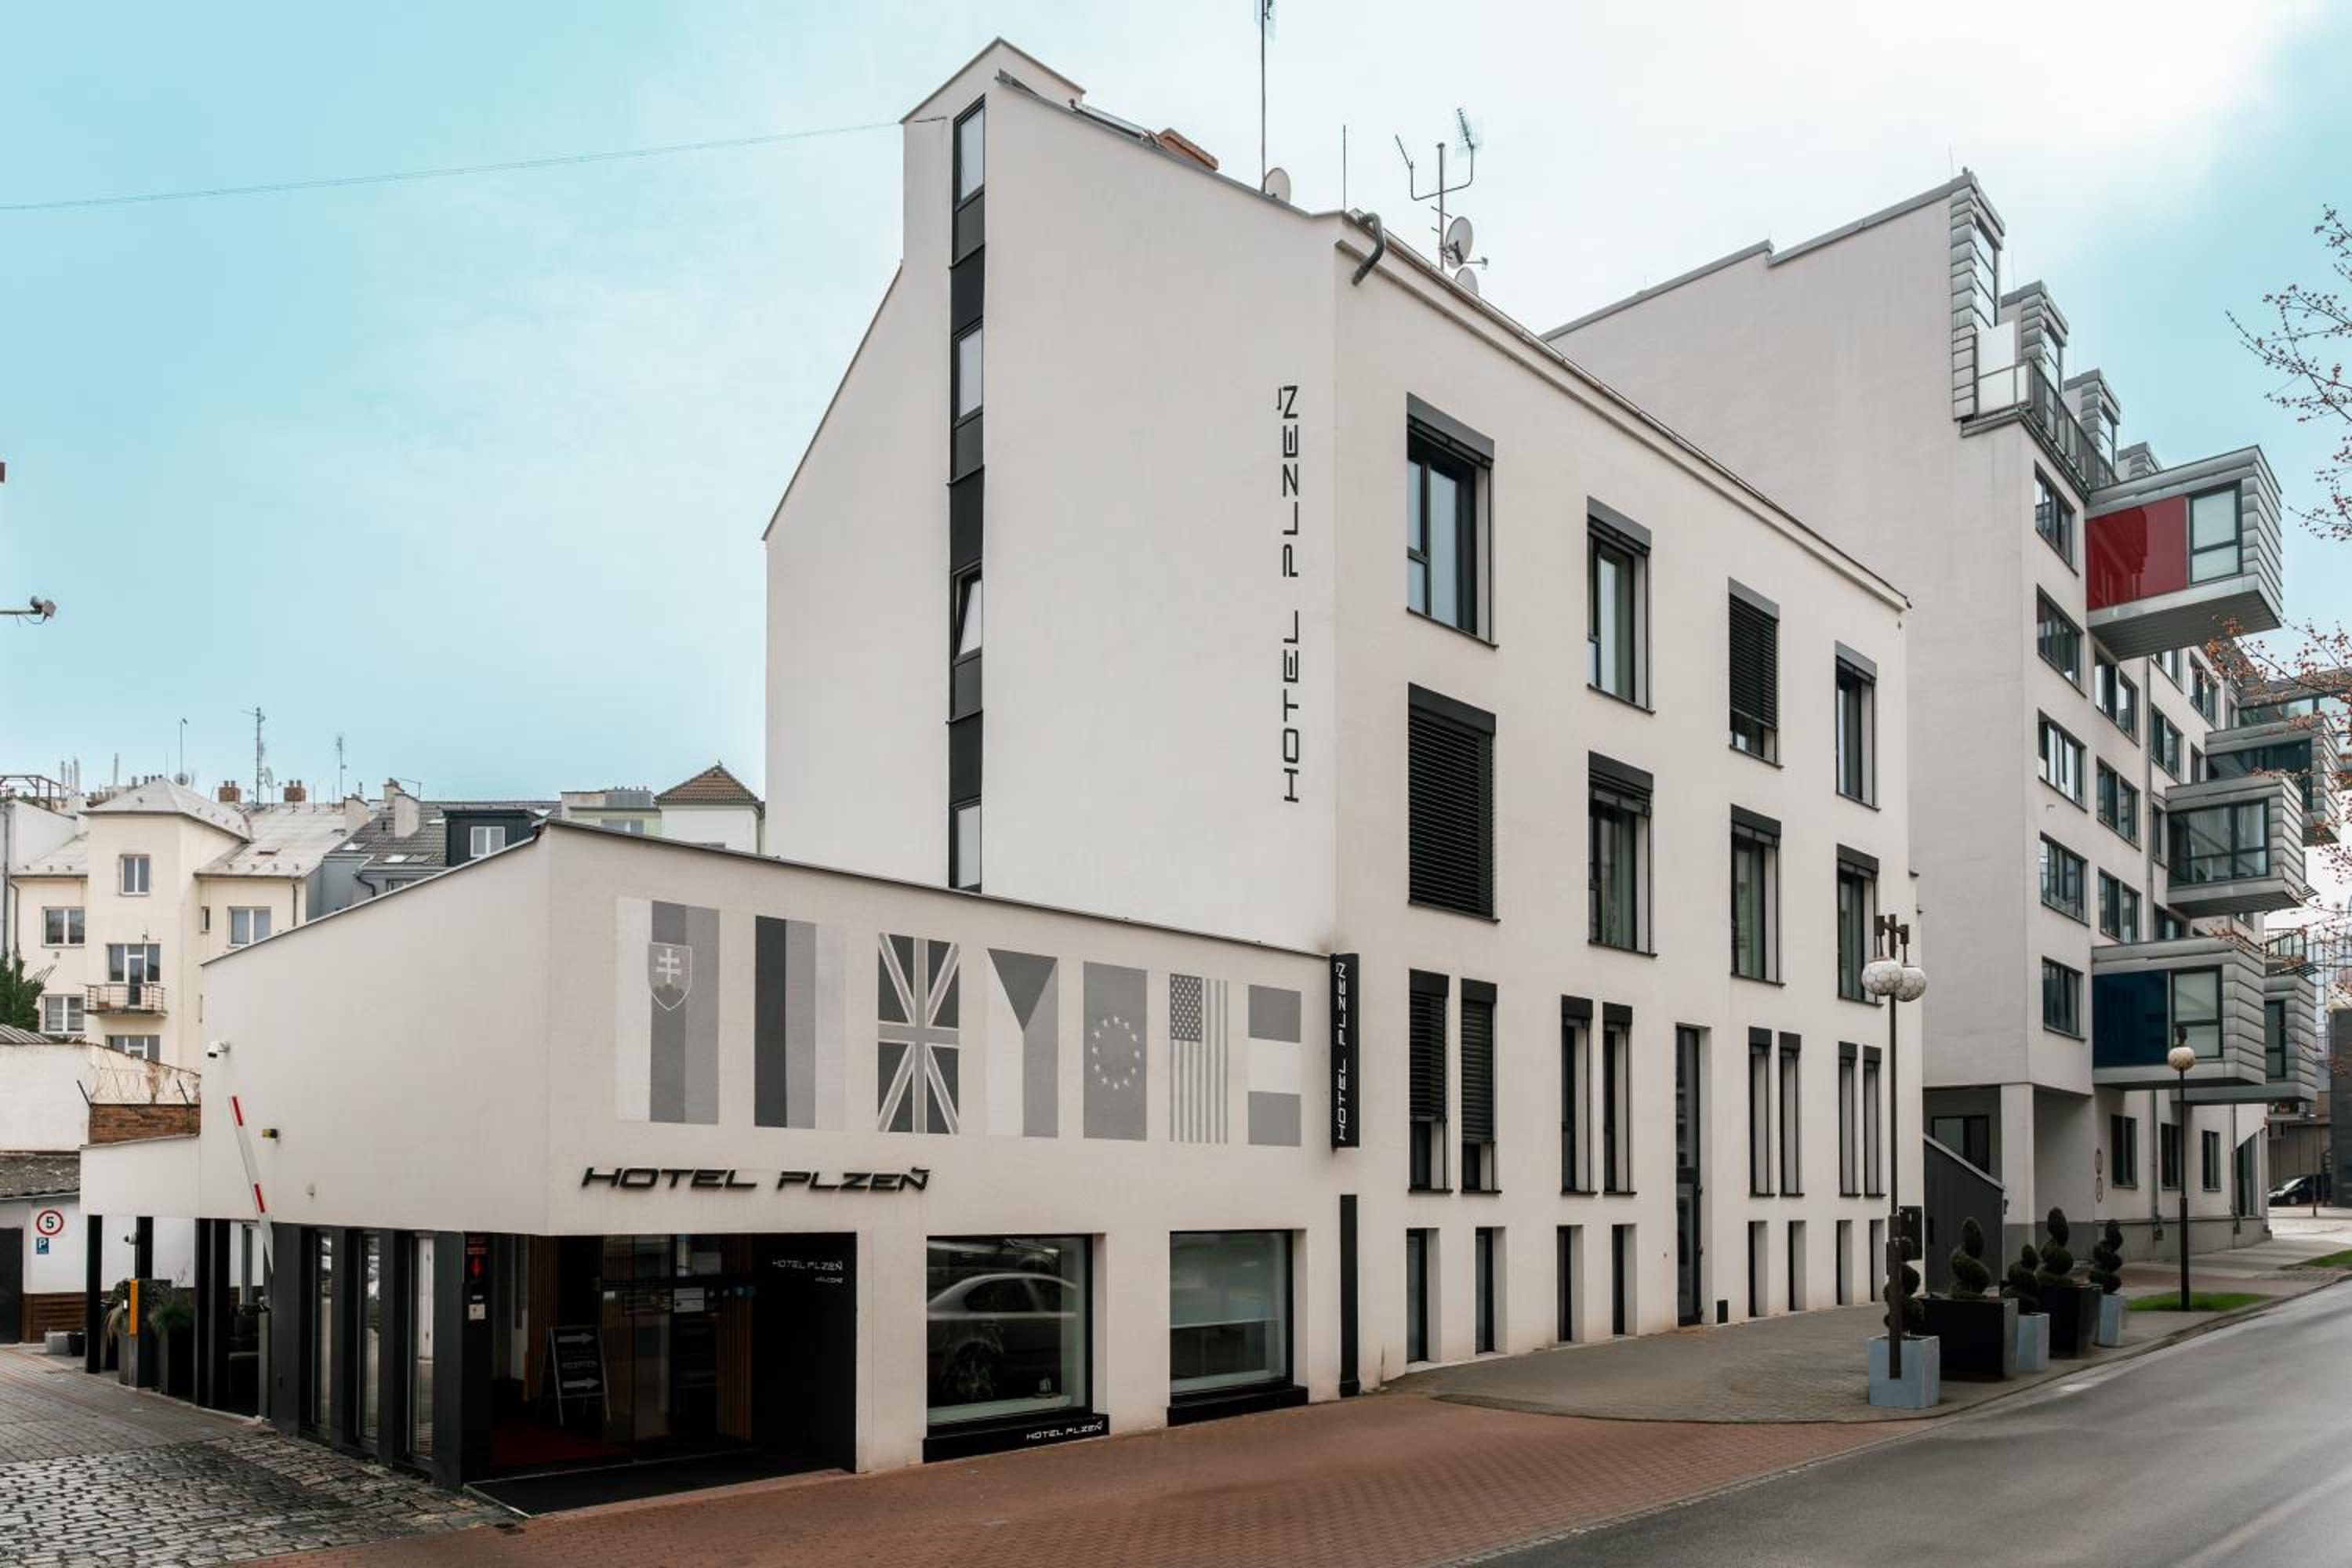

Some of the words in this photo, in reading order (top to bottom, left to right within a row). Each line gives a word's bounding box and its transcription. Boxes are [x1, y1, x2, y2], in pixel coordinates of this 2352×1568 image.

[1276, 384, 1300, 578] PLZEŇ
[1282, 609, 1300, 804] HOTEL
[1338, 1058, 1347, 1142] HOTEL
[581, 1166, 758, 1190] HOTEL
[777, 1166, 931, 1192] PLZEŇ
[45, 1215, 55, 1229] 5
[1025, 1429, 1064, 1440] HOTEL
